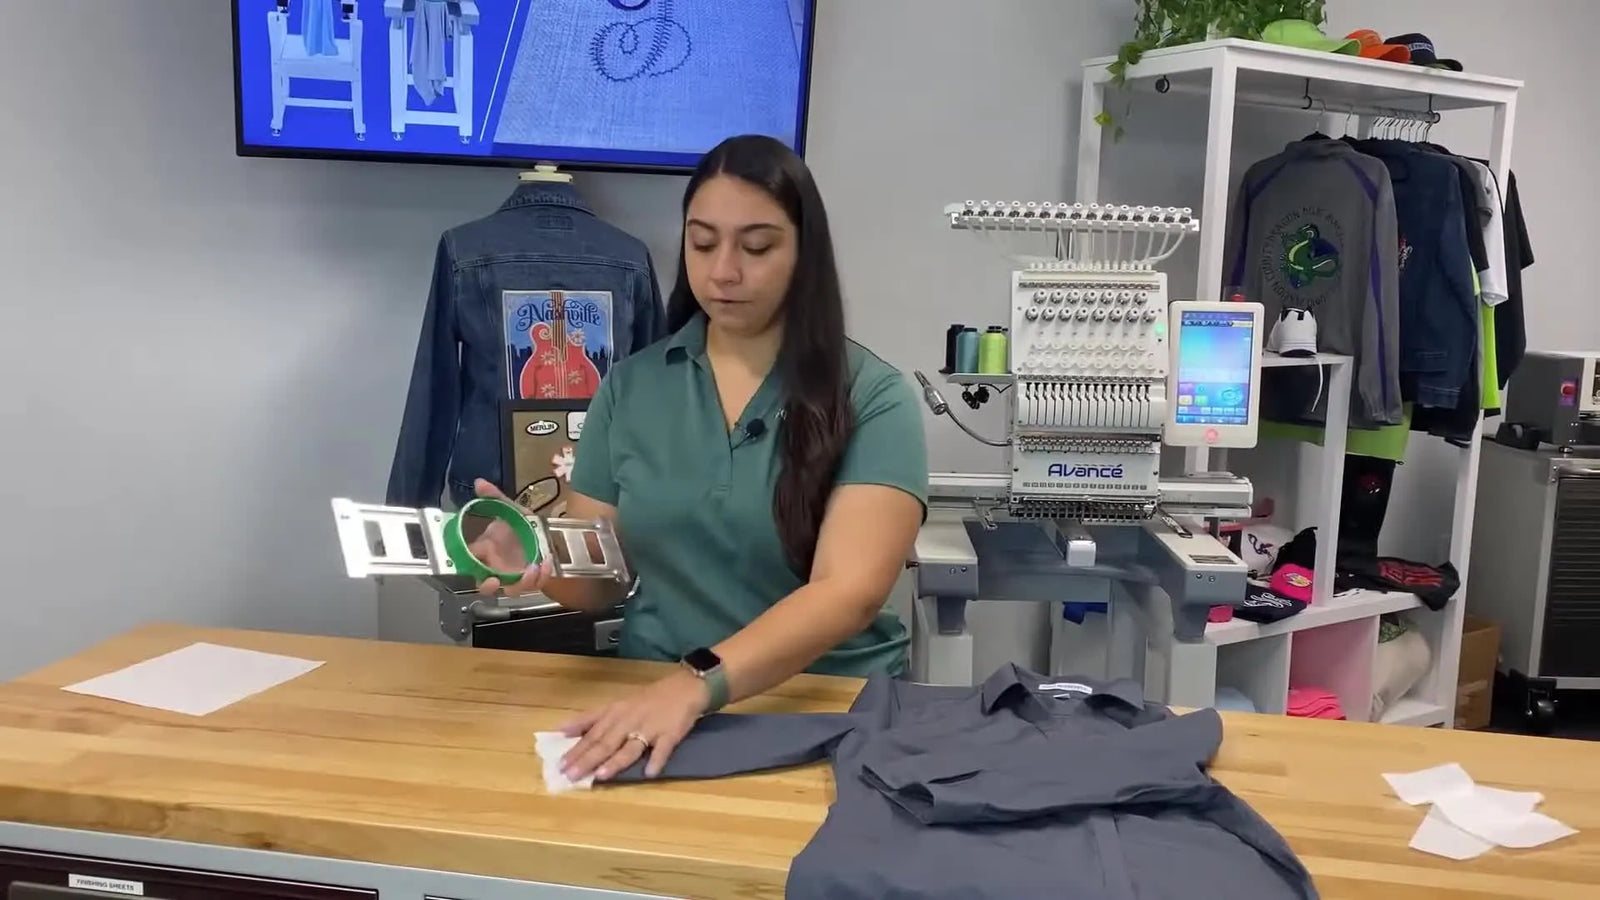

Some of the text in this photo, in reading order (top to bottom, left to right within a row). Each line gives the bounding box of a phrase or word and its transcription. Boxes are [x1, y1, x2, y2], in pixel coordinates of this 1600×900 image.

[516, 298, 601, 332] Nashville
[529, 423, 556, 432] MERLIN
[1047, 463, 1124, 479] Avancé
[76, 878, 135, 891] FINISHING SHEETS
